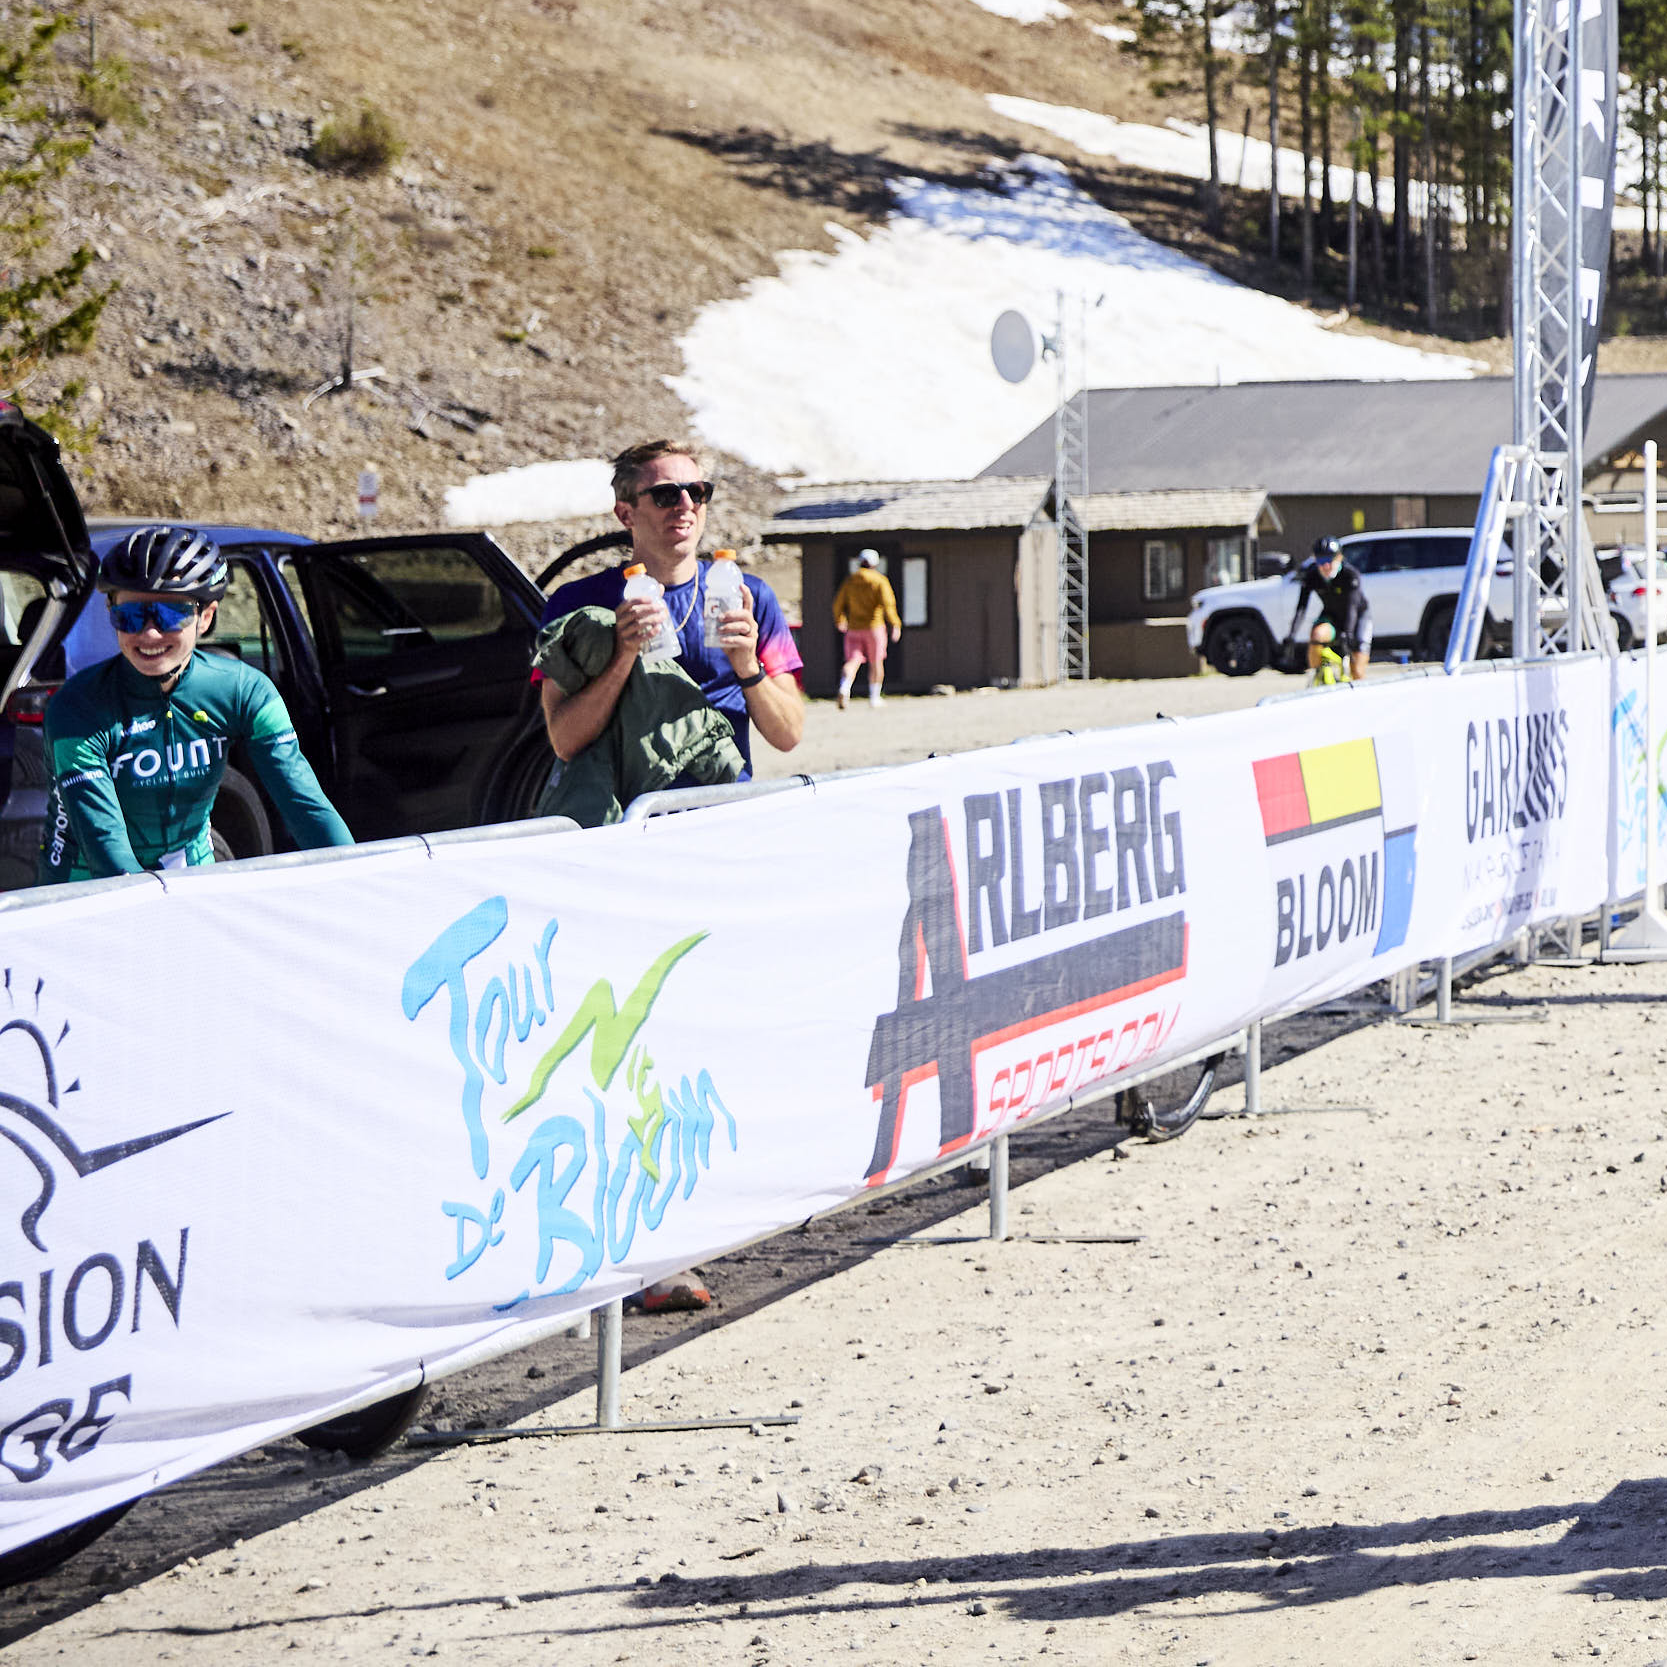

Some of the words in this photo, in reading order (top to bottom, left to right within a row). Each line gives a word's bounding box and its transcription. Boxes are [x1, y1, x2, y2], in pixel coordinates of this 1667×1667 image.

[401, 895, 558, 1180] Tour
[864, 760, 1188, 1187] ARLBERG
[1274, 850, 1378, 968] BLOOM
[493, 1068, 737, 1311] Bloom
